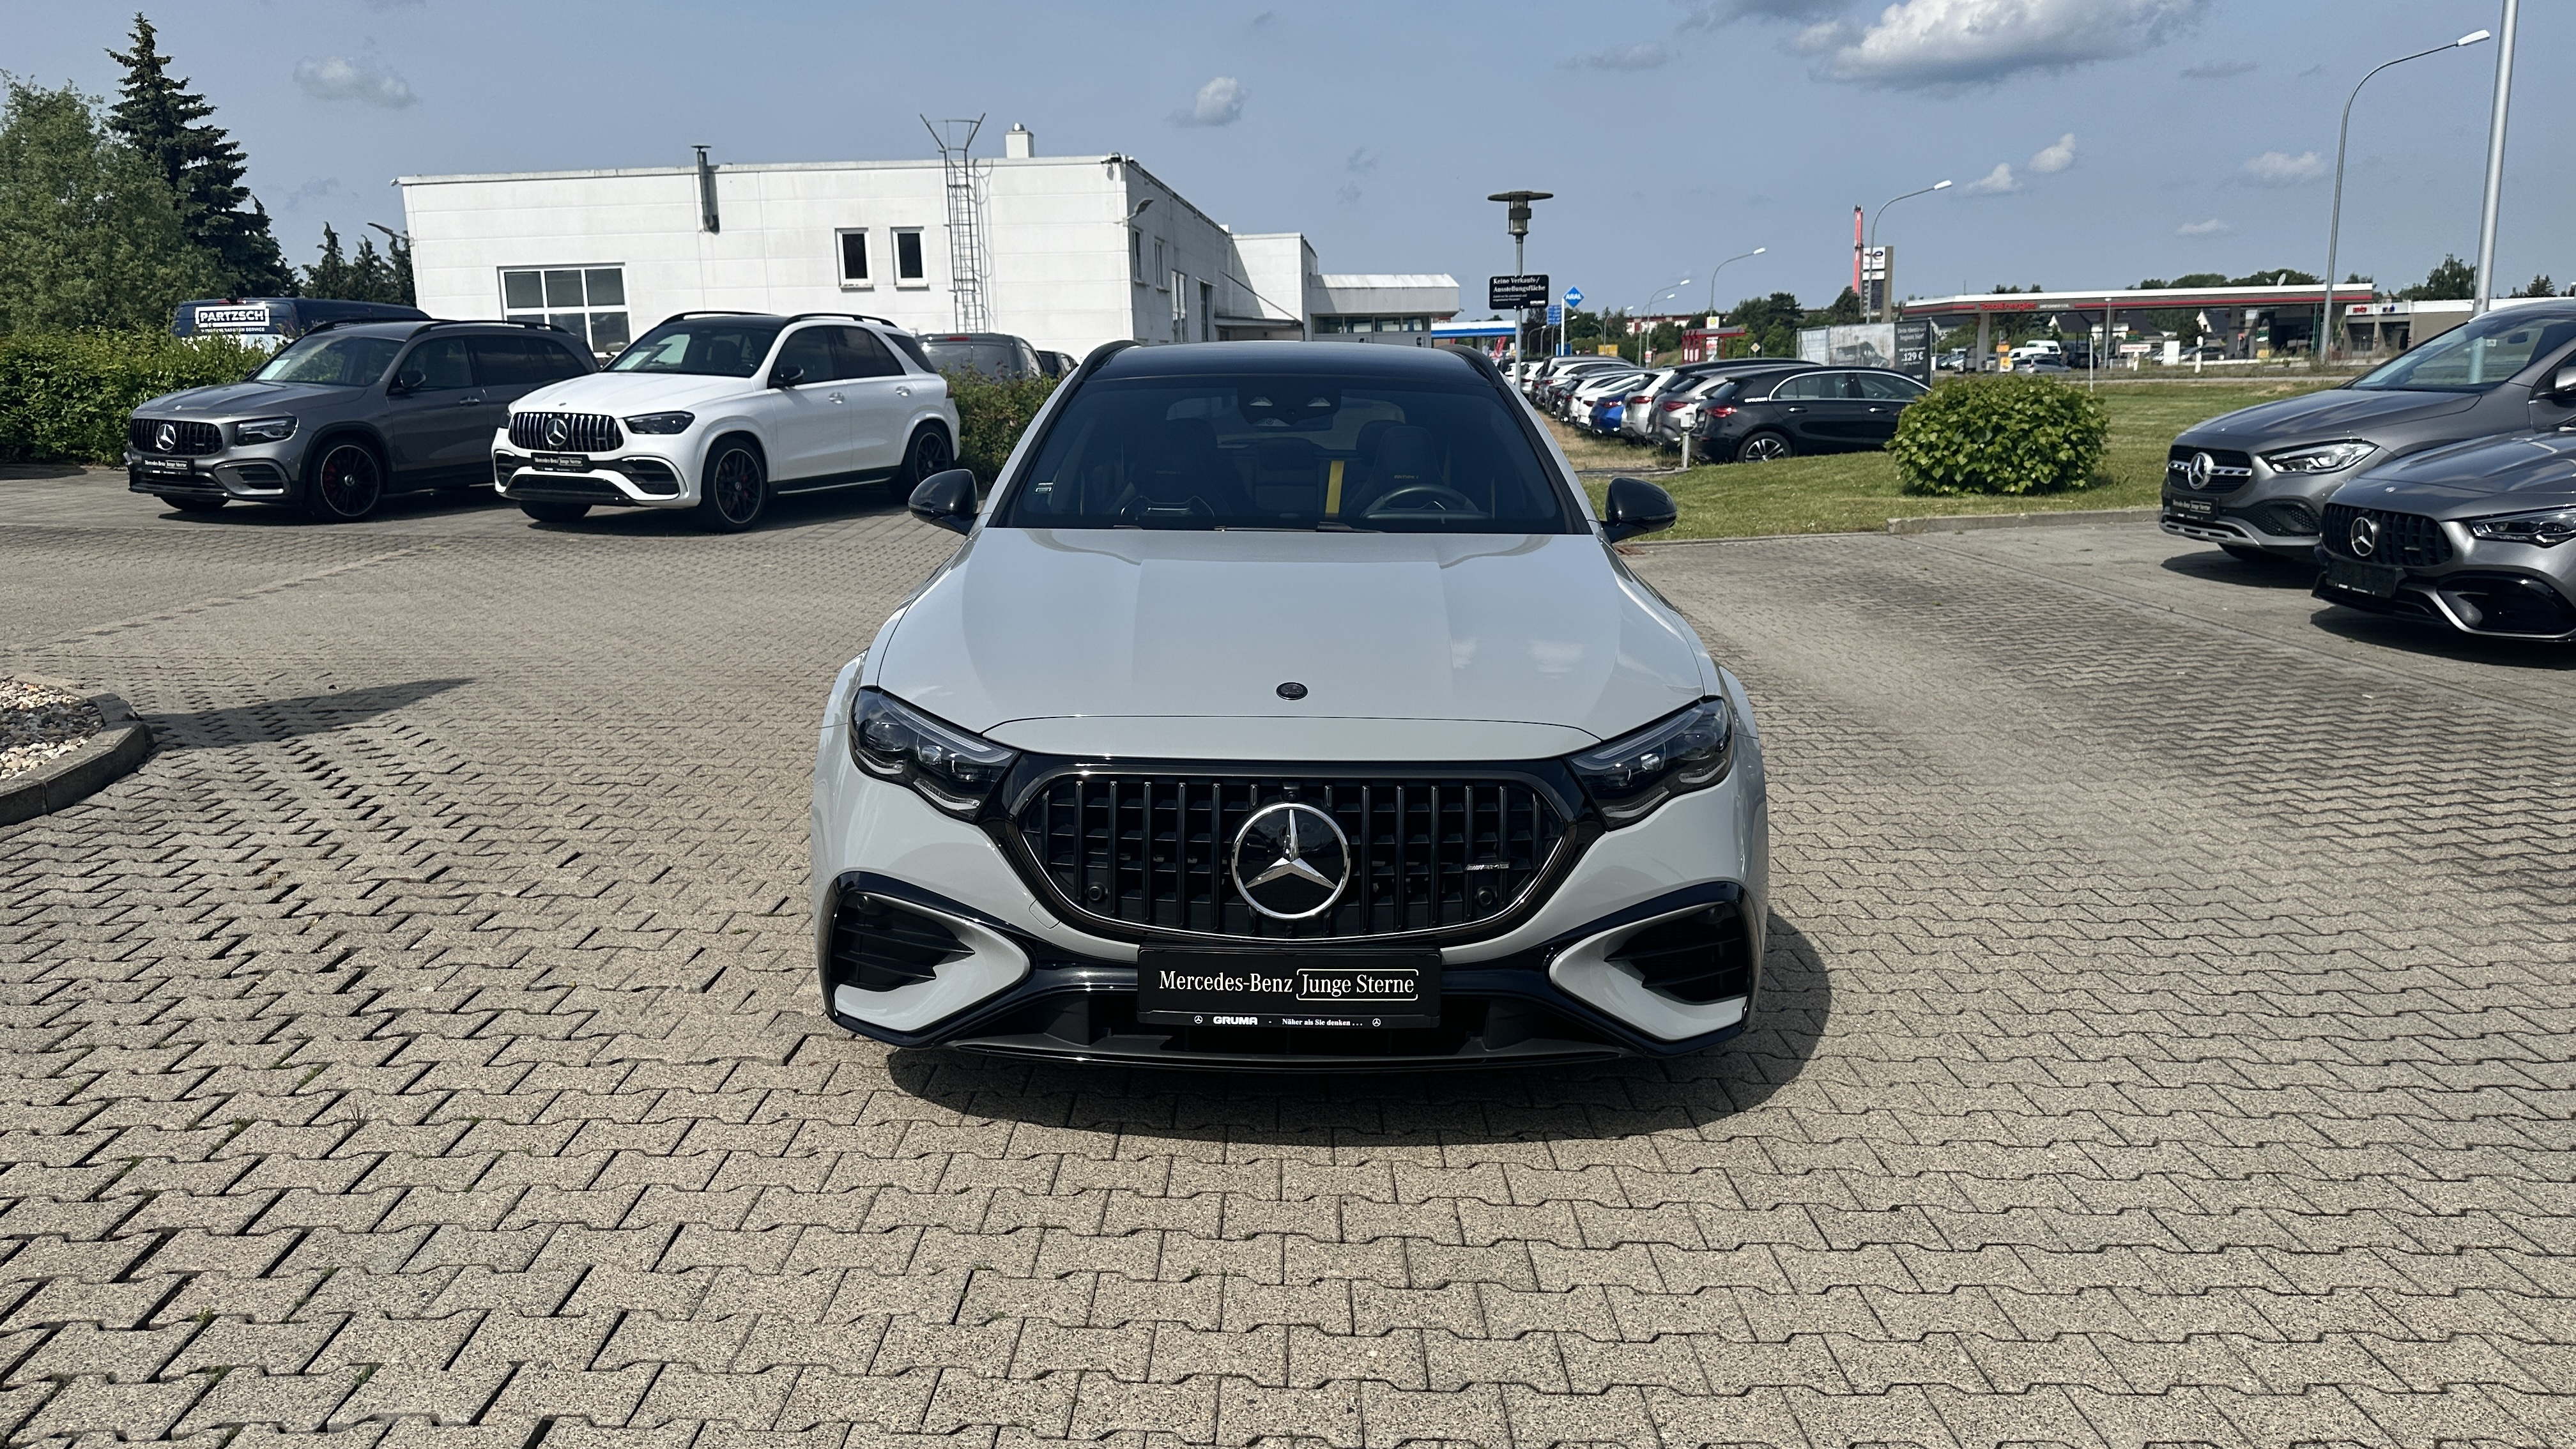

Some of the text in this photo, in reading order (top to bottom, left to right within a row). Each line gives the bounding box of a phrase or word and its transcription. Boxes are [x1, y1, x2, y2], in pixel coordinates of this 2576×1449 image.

[200, 310, 264, 323] PARTZSCH
[1159, 970, 1414, 997] Mercedes-Benz Junge Sterne
[1213, 1016, 1258, 1025] GRUMA
